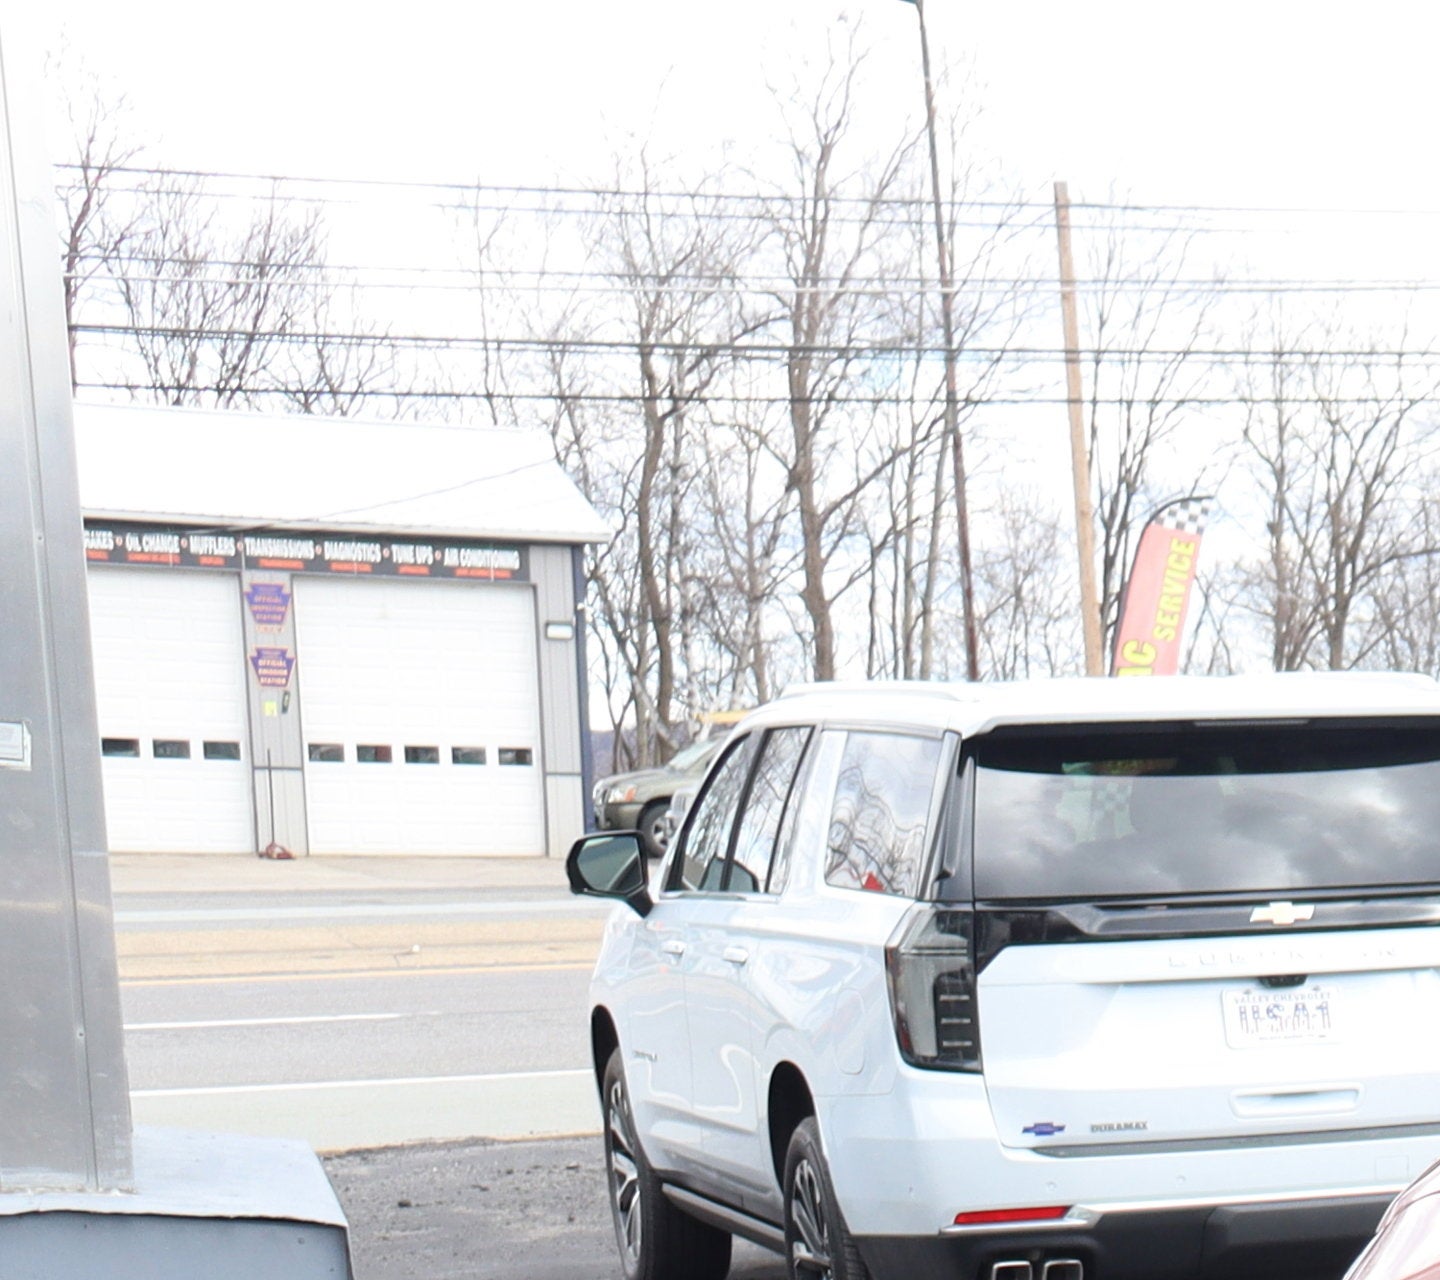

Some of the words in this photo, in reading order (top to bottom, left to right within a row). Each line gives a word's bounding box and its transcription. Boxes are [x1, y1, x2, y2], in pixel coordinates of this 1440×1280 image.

[84, 530, 114, 551] RAKES
[142, 533, 181, 554] CHANGE
[189, 534, 235, 557] MUFFLERS
[244, 537, 315, 560] TRANSMISSIONS
[324, 540, 382, 563] DIAGNOSTICS
[391, 544, 415, 565] TUNE
[415, 545, 434, 565] UPS
[460, 549, 520, 570] CONDITIONING
[1152, 537, 1196, 643] SERVICE
[1090, 1121, 1148, 1133] DURAMAX
